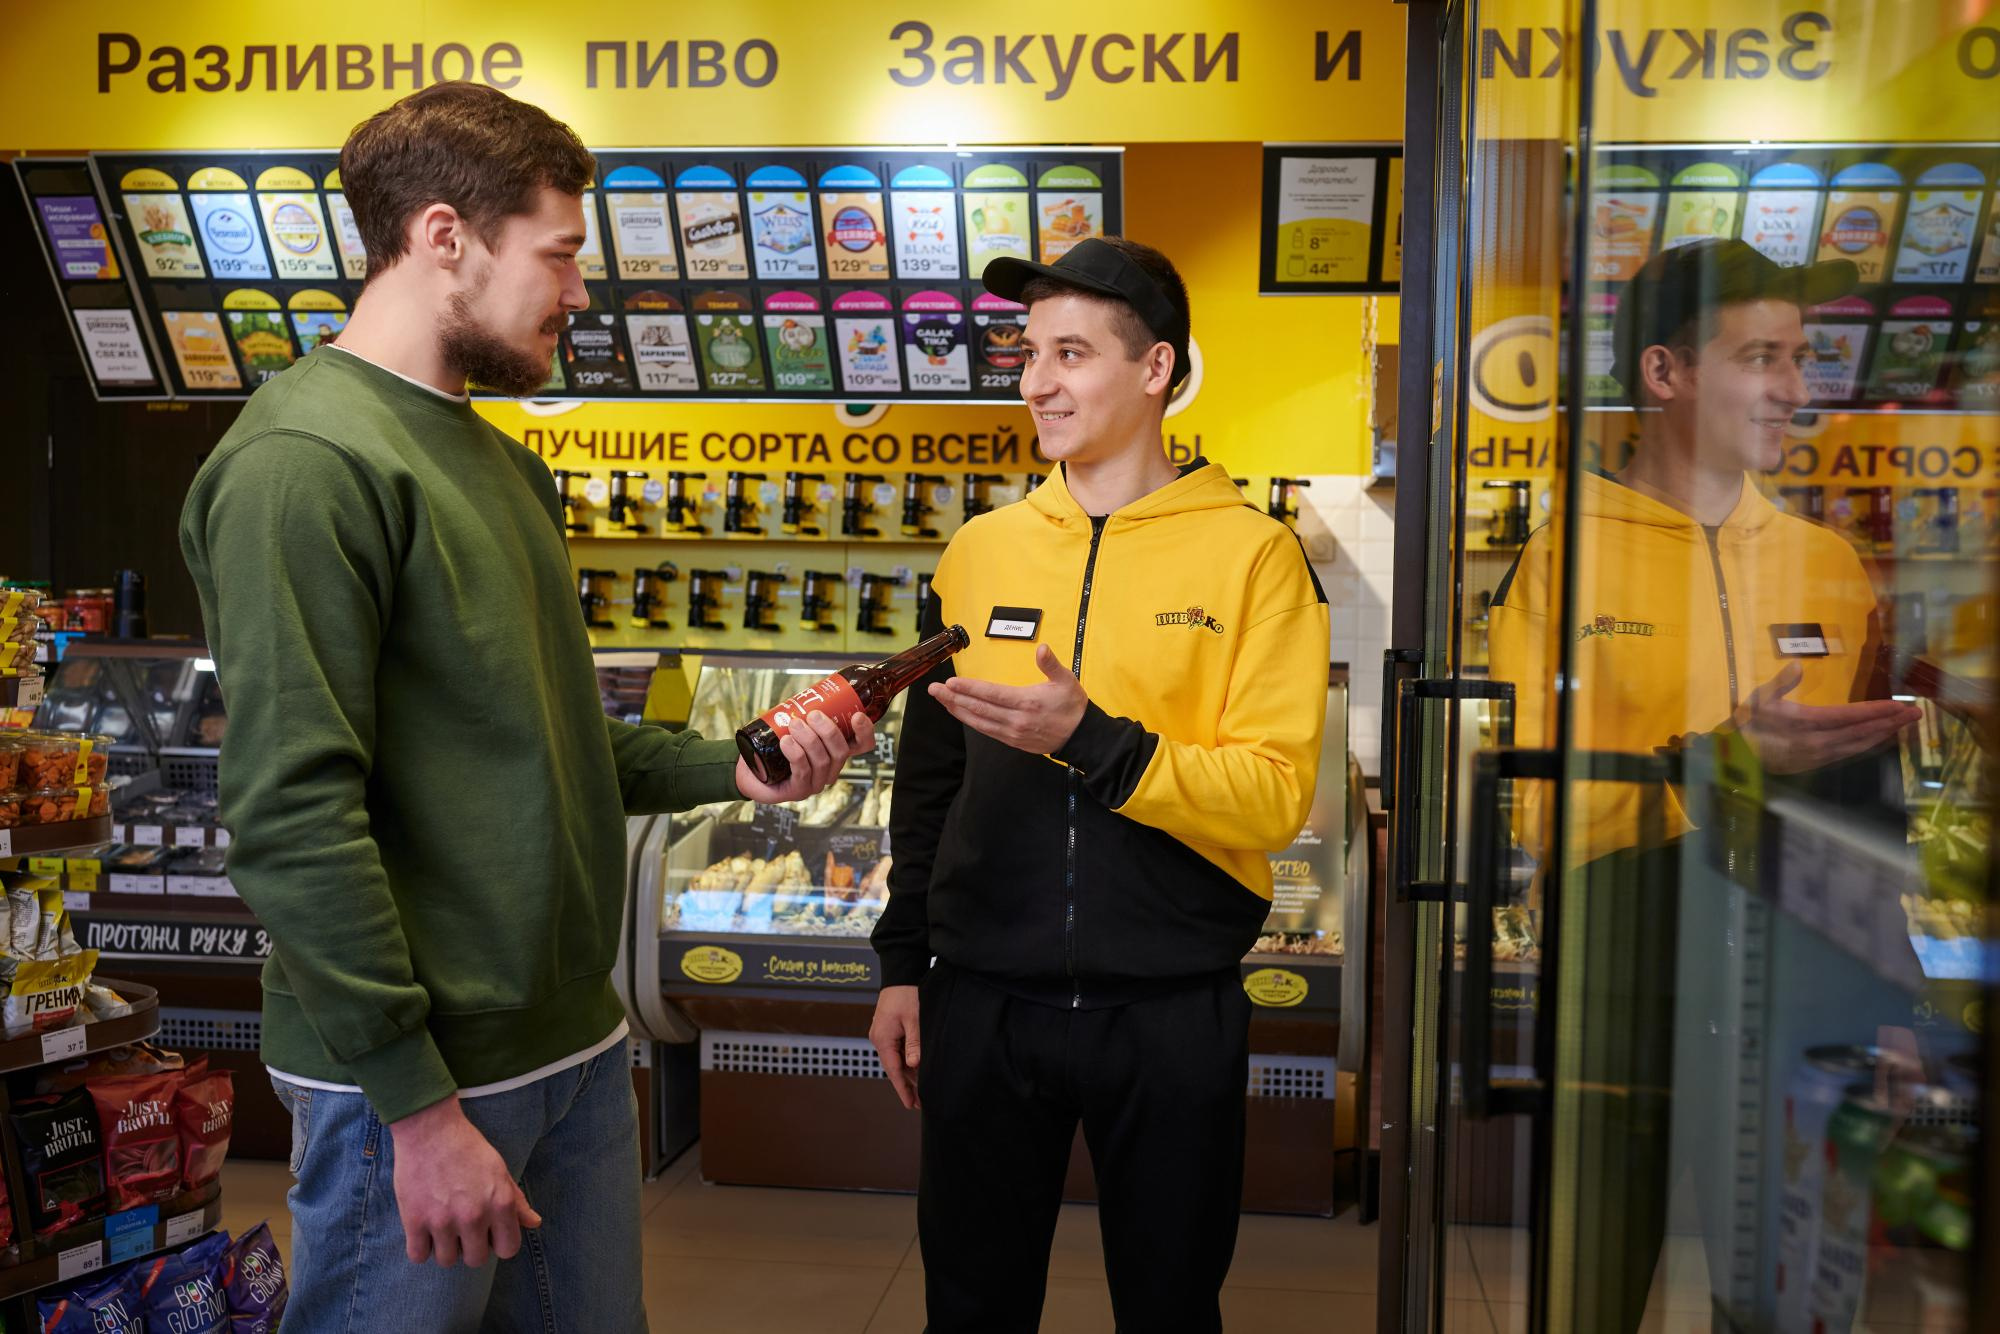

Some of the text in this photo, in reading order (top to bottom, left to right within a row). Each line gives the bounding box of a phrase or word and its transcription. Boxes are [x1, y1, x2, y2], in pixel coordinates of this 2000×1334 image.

[98, 20, 1363, 101] Разливное пиво Закуски и
[1309, 237, 1320, 250] 8
[156, 258, 176, 271] 92
[212, 258, 242, 271] 199
[279, 259, 308, 271] 159
[622, 260, 651, 272] 129
[690, 259, 719, 272] 129
[764, 259, 790, 271] 117
[832, 259, 861, 272] 129
[901, 259, 931, 271] 139
[1309, 263, 1330, 275] 44
[915, 328, 954, 338] GALAK
[922, 337, 949, 346] TIKA
[188, 370, 214, 382] 119
[576, 371, 604, 384] 129
[646, 373, 670, 384] 117
[710, 373, 737, 385] 127
[777, 373, 807, 385] 109
[847, 374, 875, 385] 109
[913, 374, 941, 385] 109
[981, 374, 1011, 387] 229
[700, 432, 833, 463] СОРТА
[842, 433, 901, 464] СО
[911, 426, 1019, 465] ВСЕЙ
[88, 922, 181, 951] ПРОТЯНИ
[190, 927, 247, 956] РУКУ
[128, 1099, 161, 1119] JUST
[50, 1117, 84, 1141] JUST
[117, 1112, 173, 1134] BRUTAL
[44, 1130, 96, 1159] BRUTAL
[174, 1274, 214, 1308] BON
[167, 1288, 227, 1334] GIORNO
